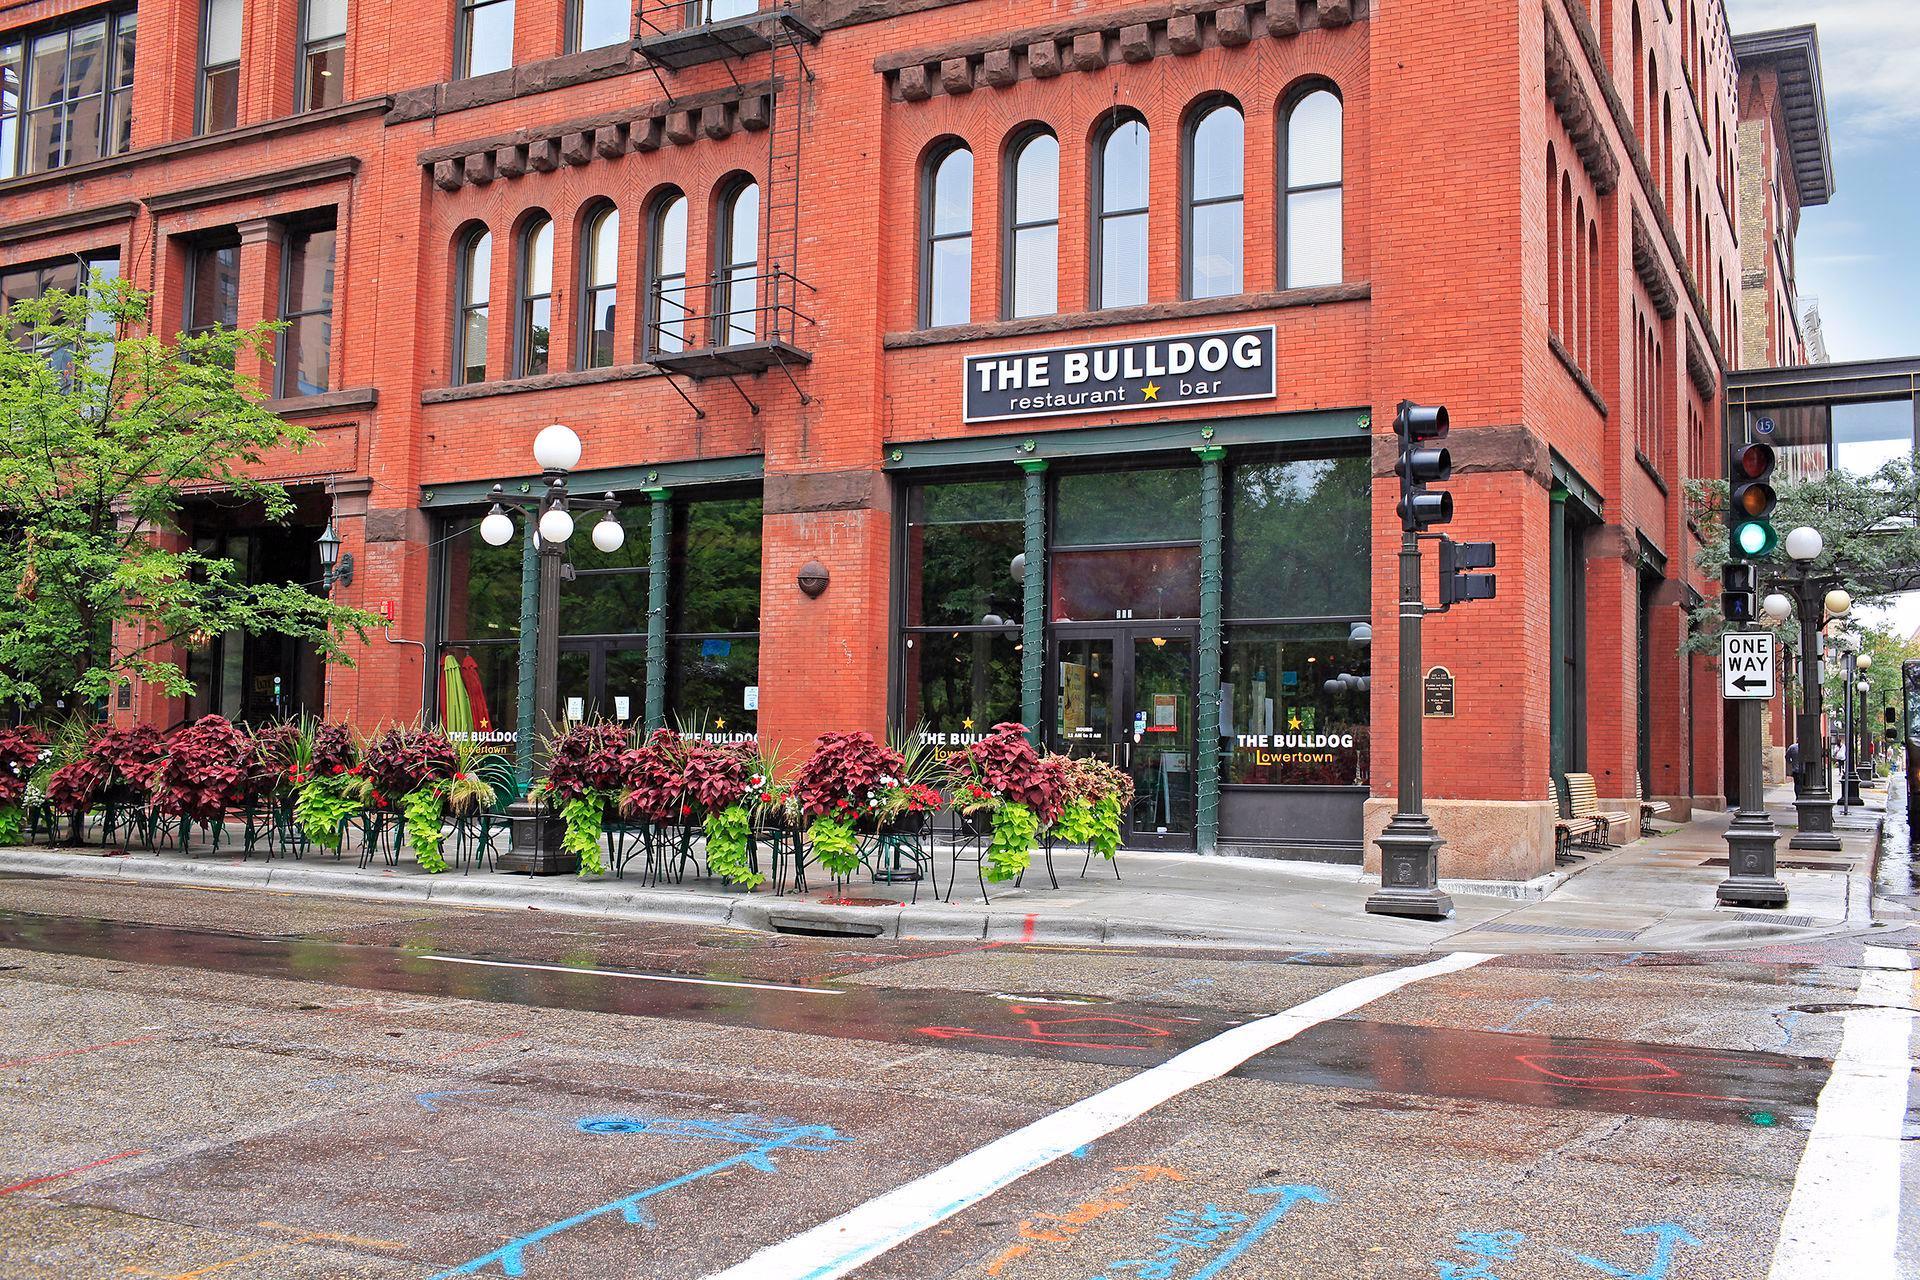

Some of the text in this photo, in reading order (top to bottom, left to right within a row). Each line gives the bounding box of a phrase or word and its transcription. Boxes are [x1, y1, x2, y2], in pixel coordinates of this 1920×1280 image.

[975, 334, 1263, 393] THE BULLDOG
[1009, 378, 1222, 411] restaurant bar
[1760, 421, 1771, 431] 15
[1729, 638, 1767, 654] ONE
[1728, 656, 1768, 672] WAY
[448, 731, 468, 742] THE
[678, 732, 702, 743] THE
[918, 732, 993, 745] THE BULL
[1236, 734, 1354, 748] THE BULLDOG
[1256, 749, 1333, 766] Lowertown
